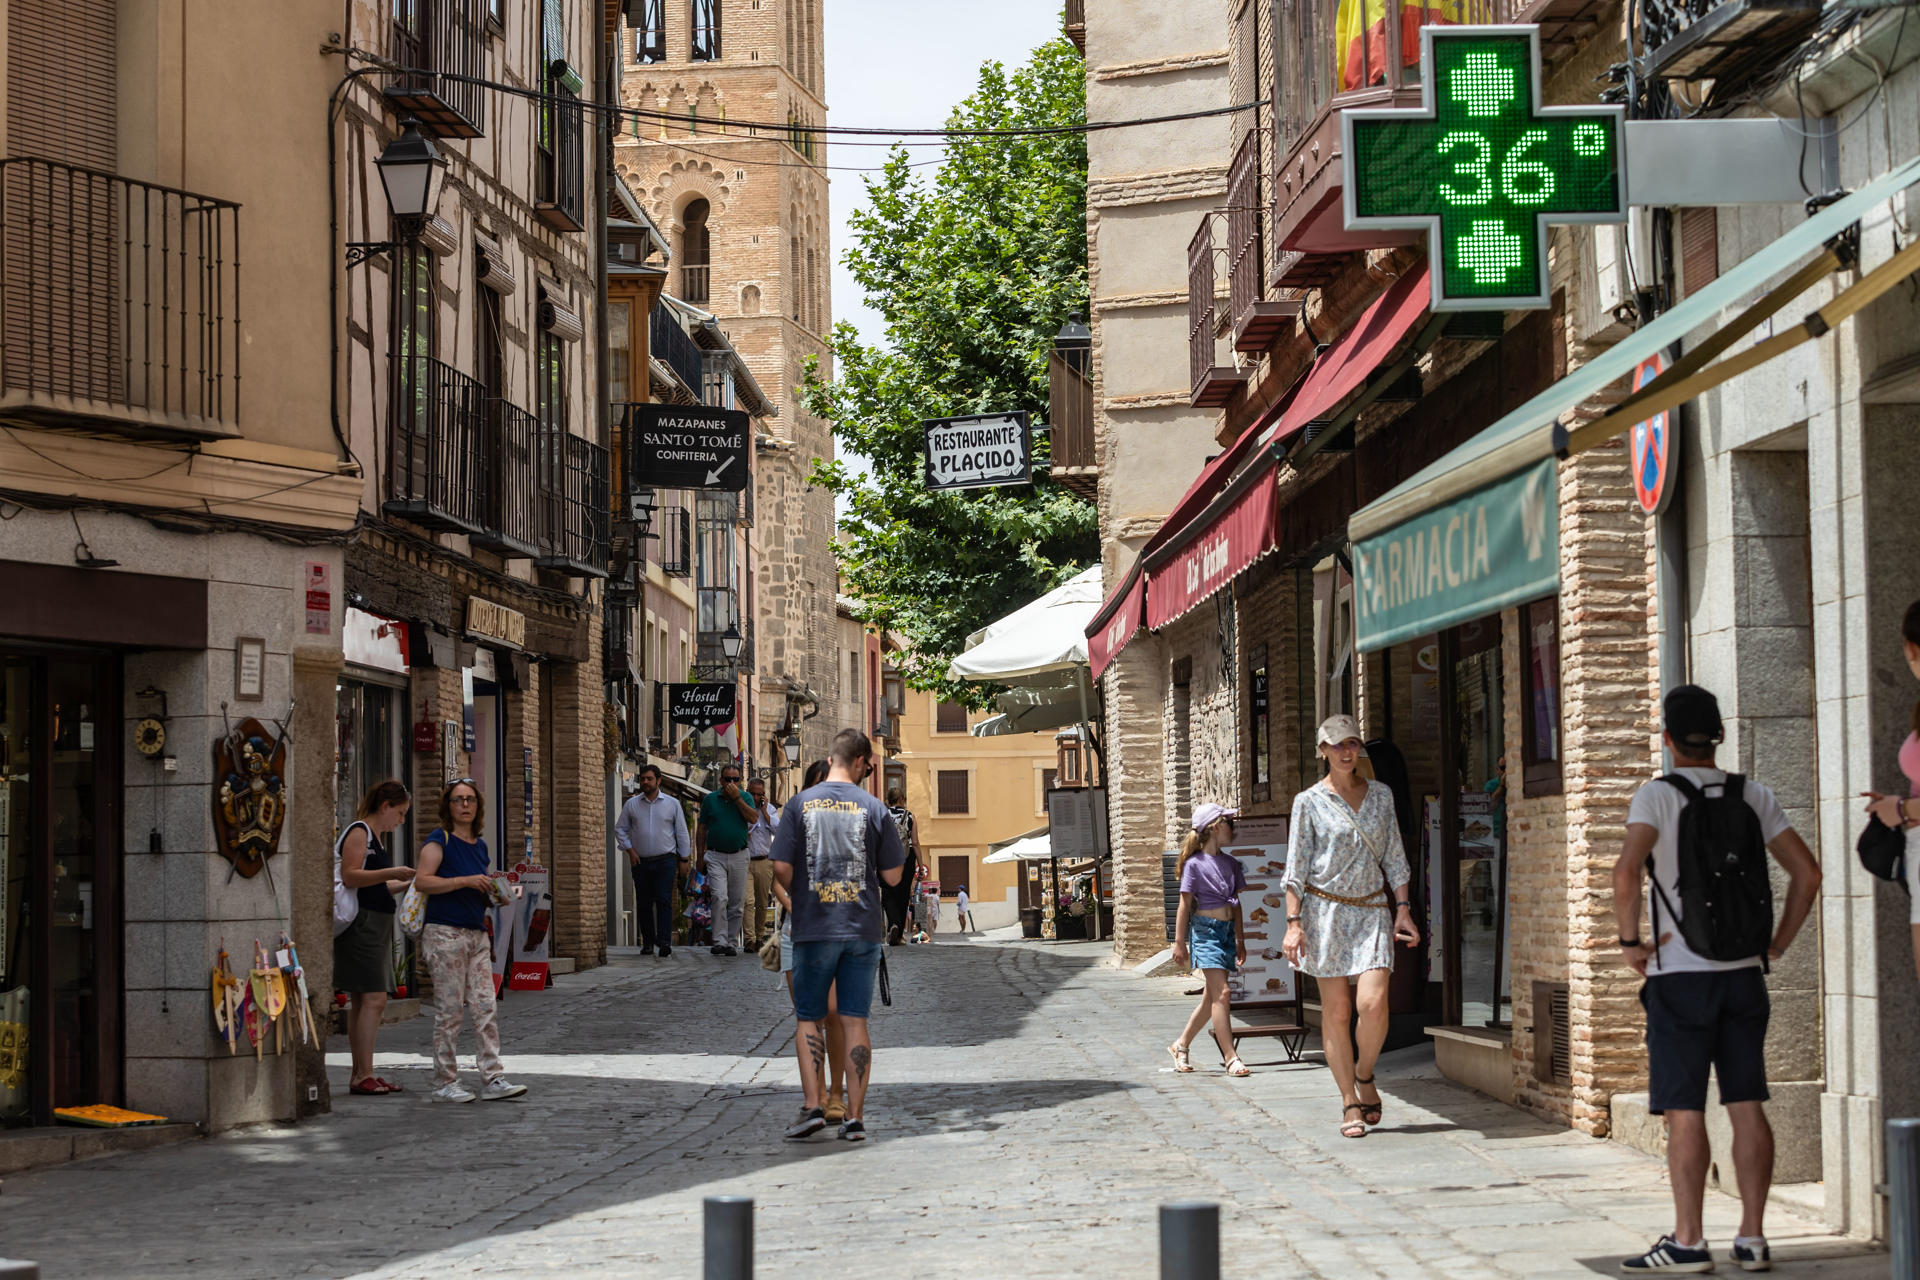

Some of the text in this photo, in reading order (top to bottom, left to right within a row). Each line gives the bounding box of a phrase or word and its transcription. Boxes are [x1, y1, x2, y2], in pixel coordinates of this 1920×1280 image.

[657, 417, 726, 430] MAZAPANES
[643, 432, 742, 448] SANTO TOMÉ
[934, 426, 1016, 451] RESTAURANTE
[656, 450, 718, 462] CONFITERIA
[940, 449, 1015, 473] PLACIDO
[1359, 505, 1490, 617] FARMACIA
[681, 686, 724, 702] Hostal
[672, 704, 732, 717] Santo Tomé
